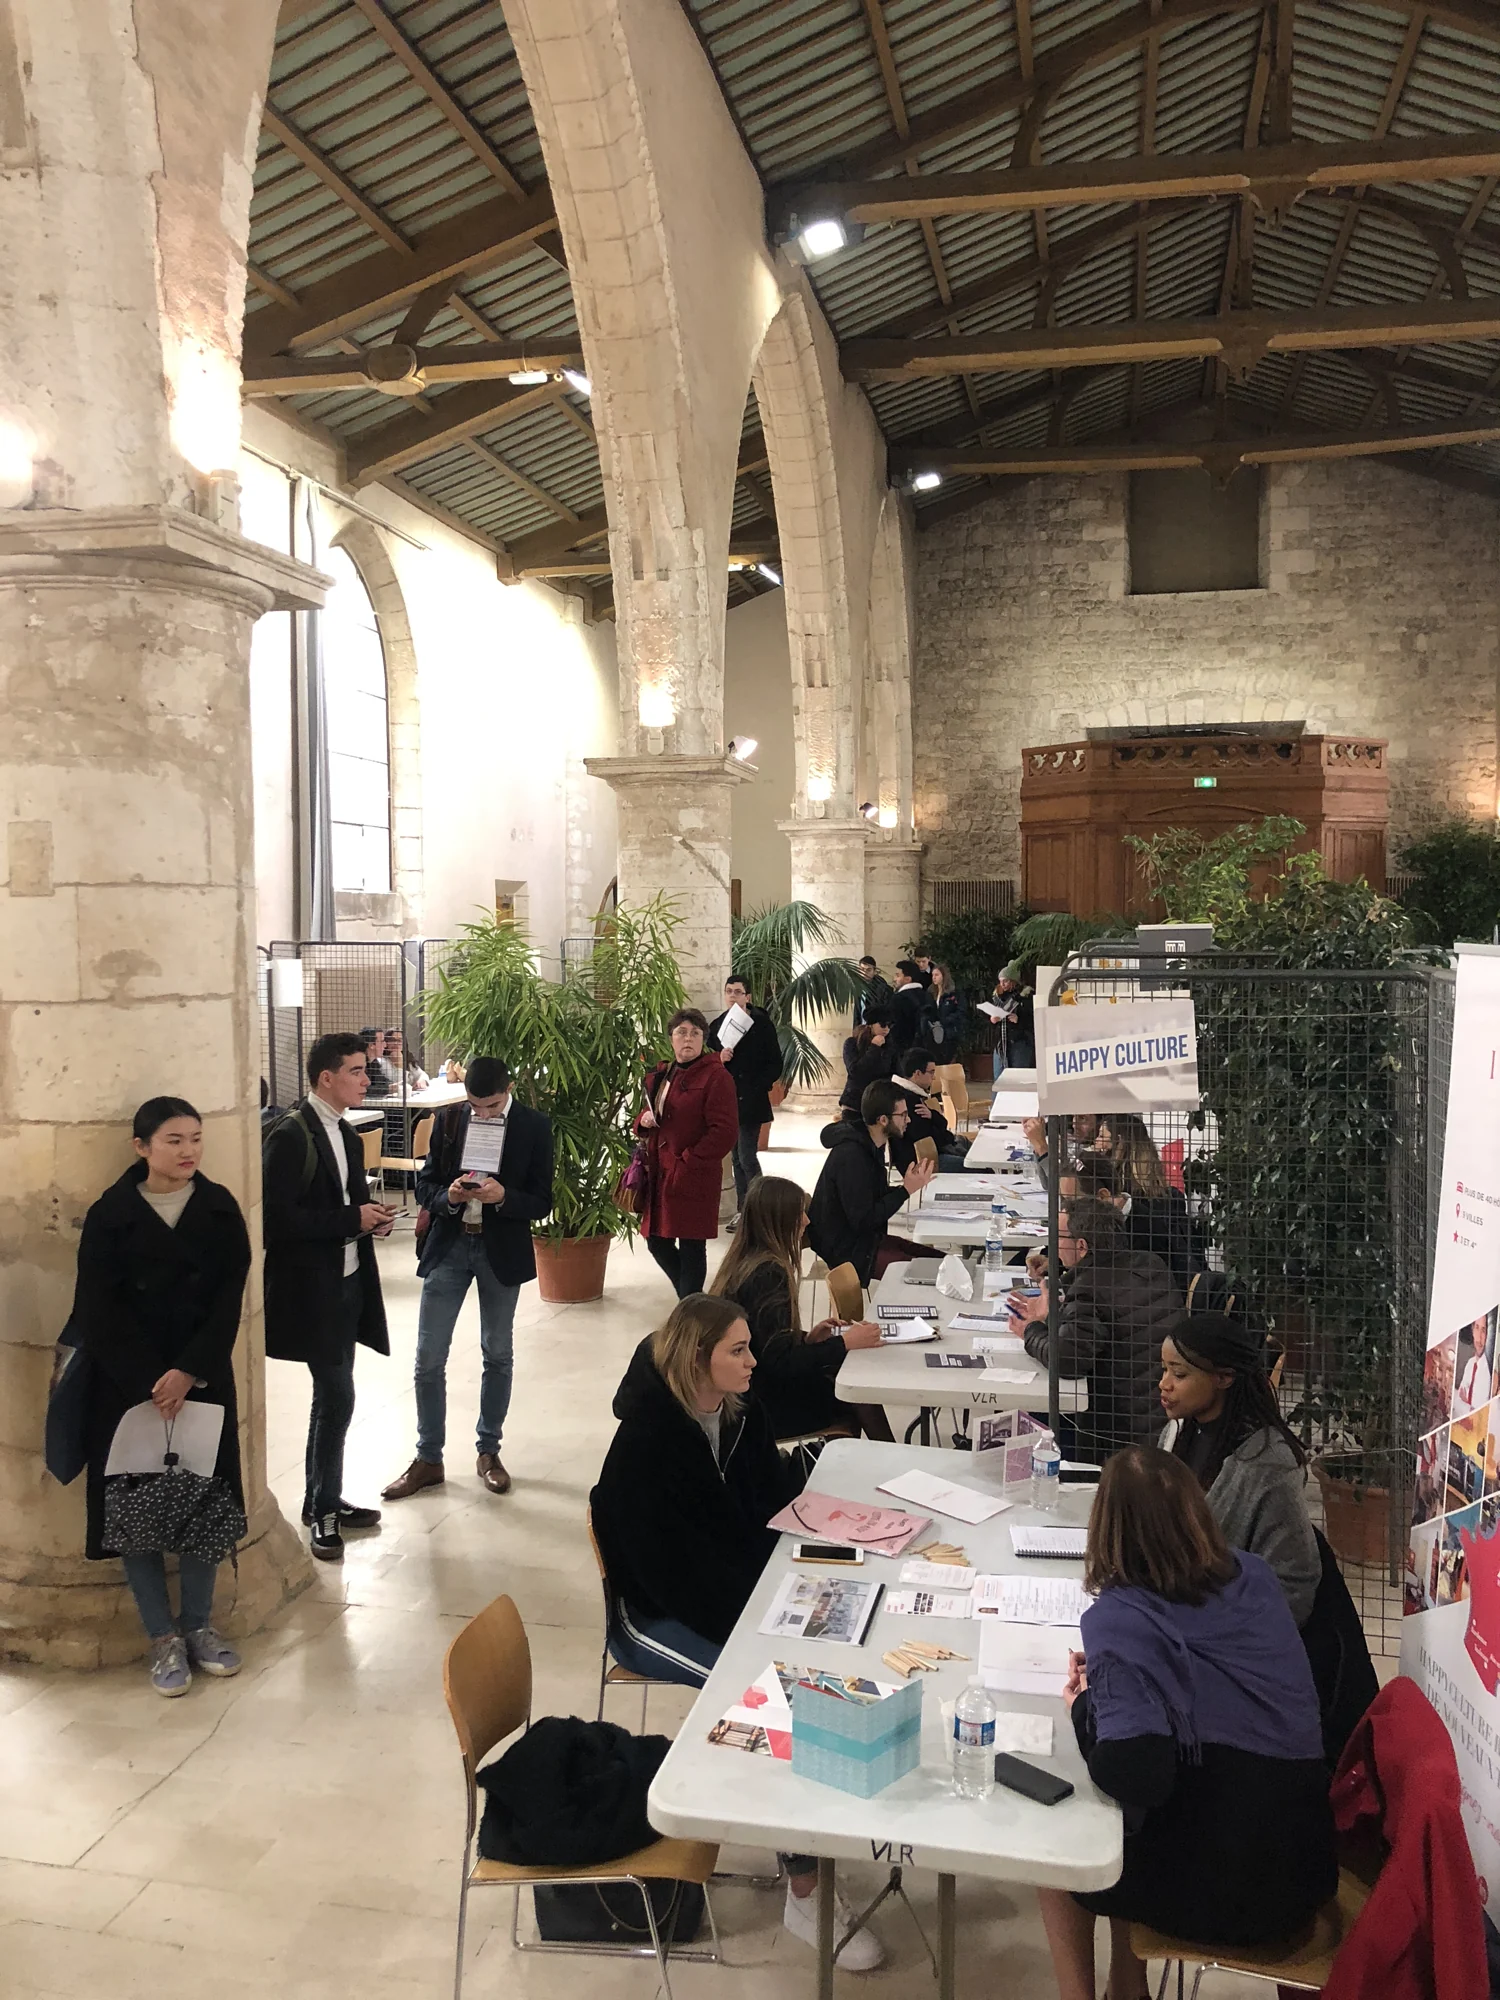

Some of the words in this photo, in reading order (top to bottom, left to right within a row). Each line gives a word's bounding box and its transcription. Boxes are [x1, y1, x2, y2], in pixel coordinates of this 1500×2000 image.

[1055, 1045, 1110, 1075] HAPPY
[1115, 1034, 1188, 1067] CULTURE
[1477, 1191, 1484, 1201] DE
[1485, 1195, 1492, 1204] 40
[1466, 1212, 1483, 1226] VILLES
[971, 1392, 998, 1404] VLR
[1427, 1683, 1441, 1712] DE
[871, 1838, 915, 1867] VLR
